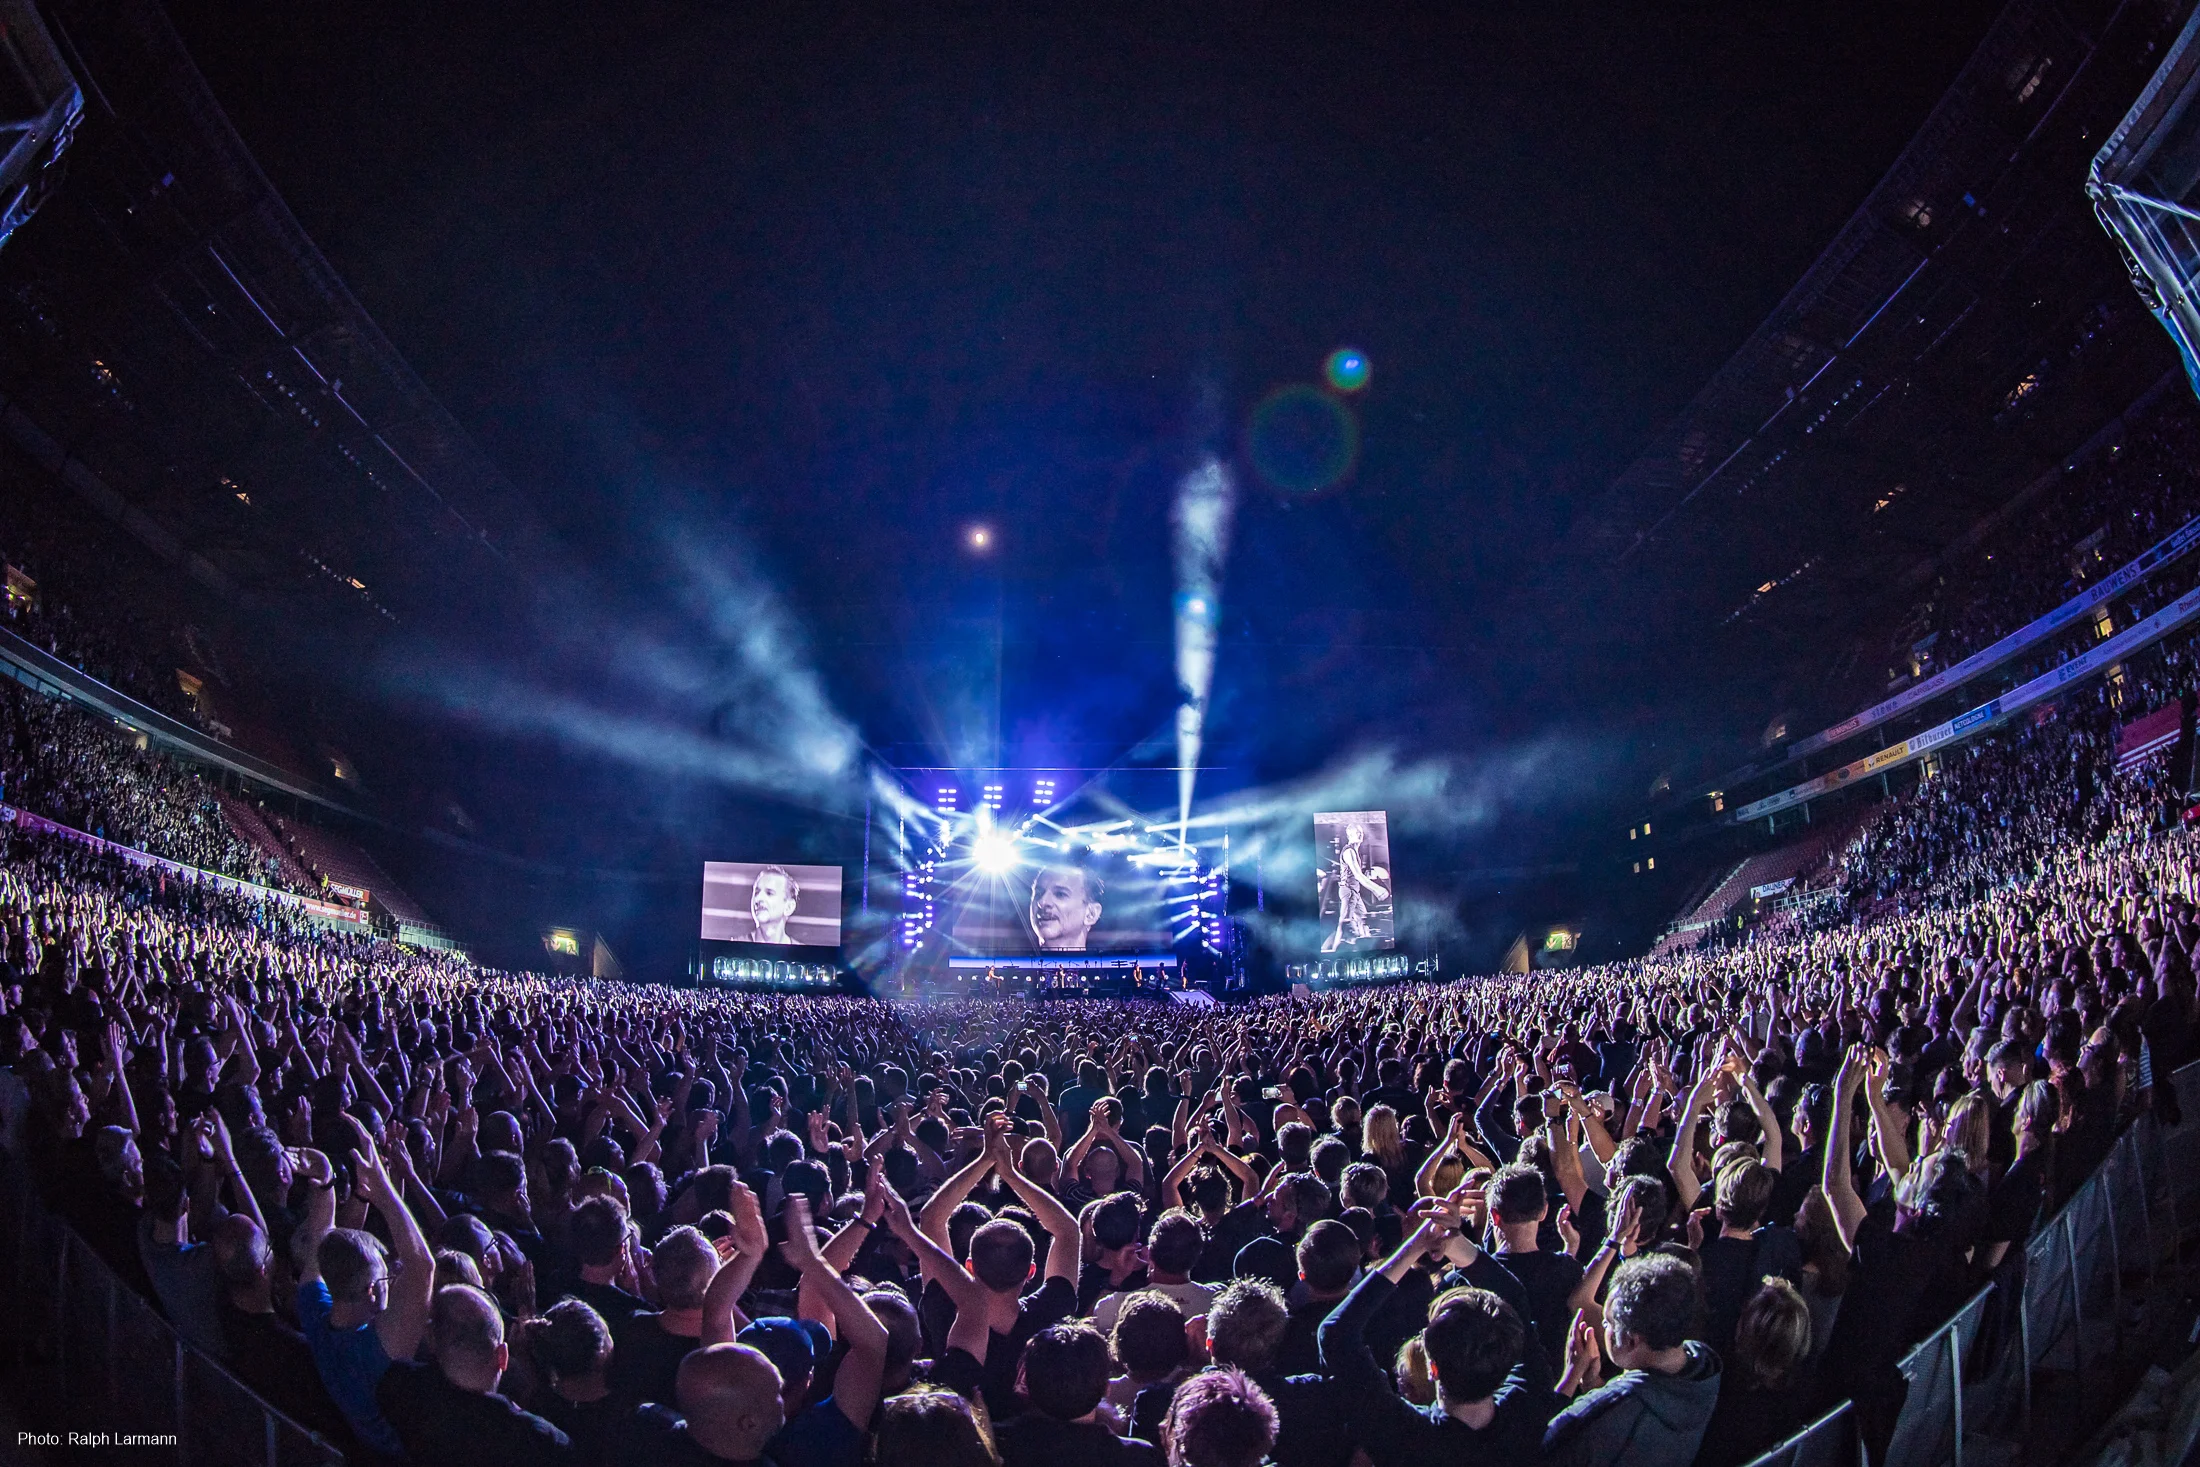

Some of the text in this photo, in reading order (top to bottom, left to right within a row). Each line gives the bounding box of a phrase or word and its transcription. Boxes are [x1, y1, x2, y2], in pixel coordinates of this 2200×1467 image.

[2090, 564, 2137, 601] BAUWENS
[2178, 594, 2200, 613] Rhein
[1954, 710, 1985, 730] NETCOLOGNE
[1917, 726, 1952, 748] Bitburger
[1875, 747, 1904, 764] RENAULT
